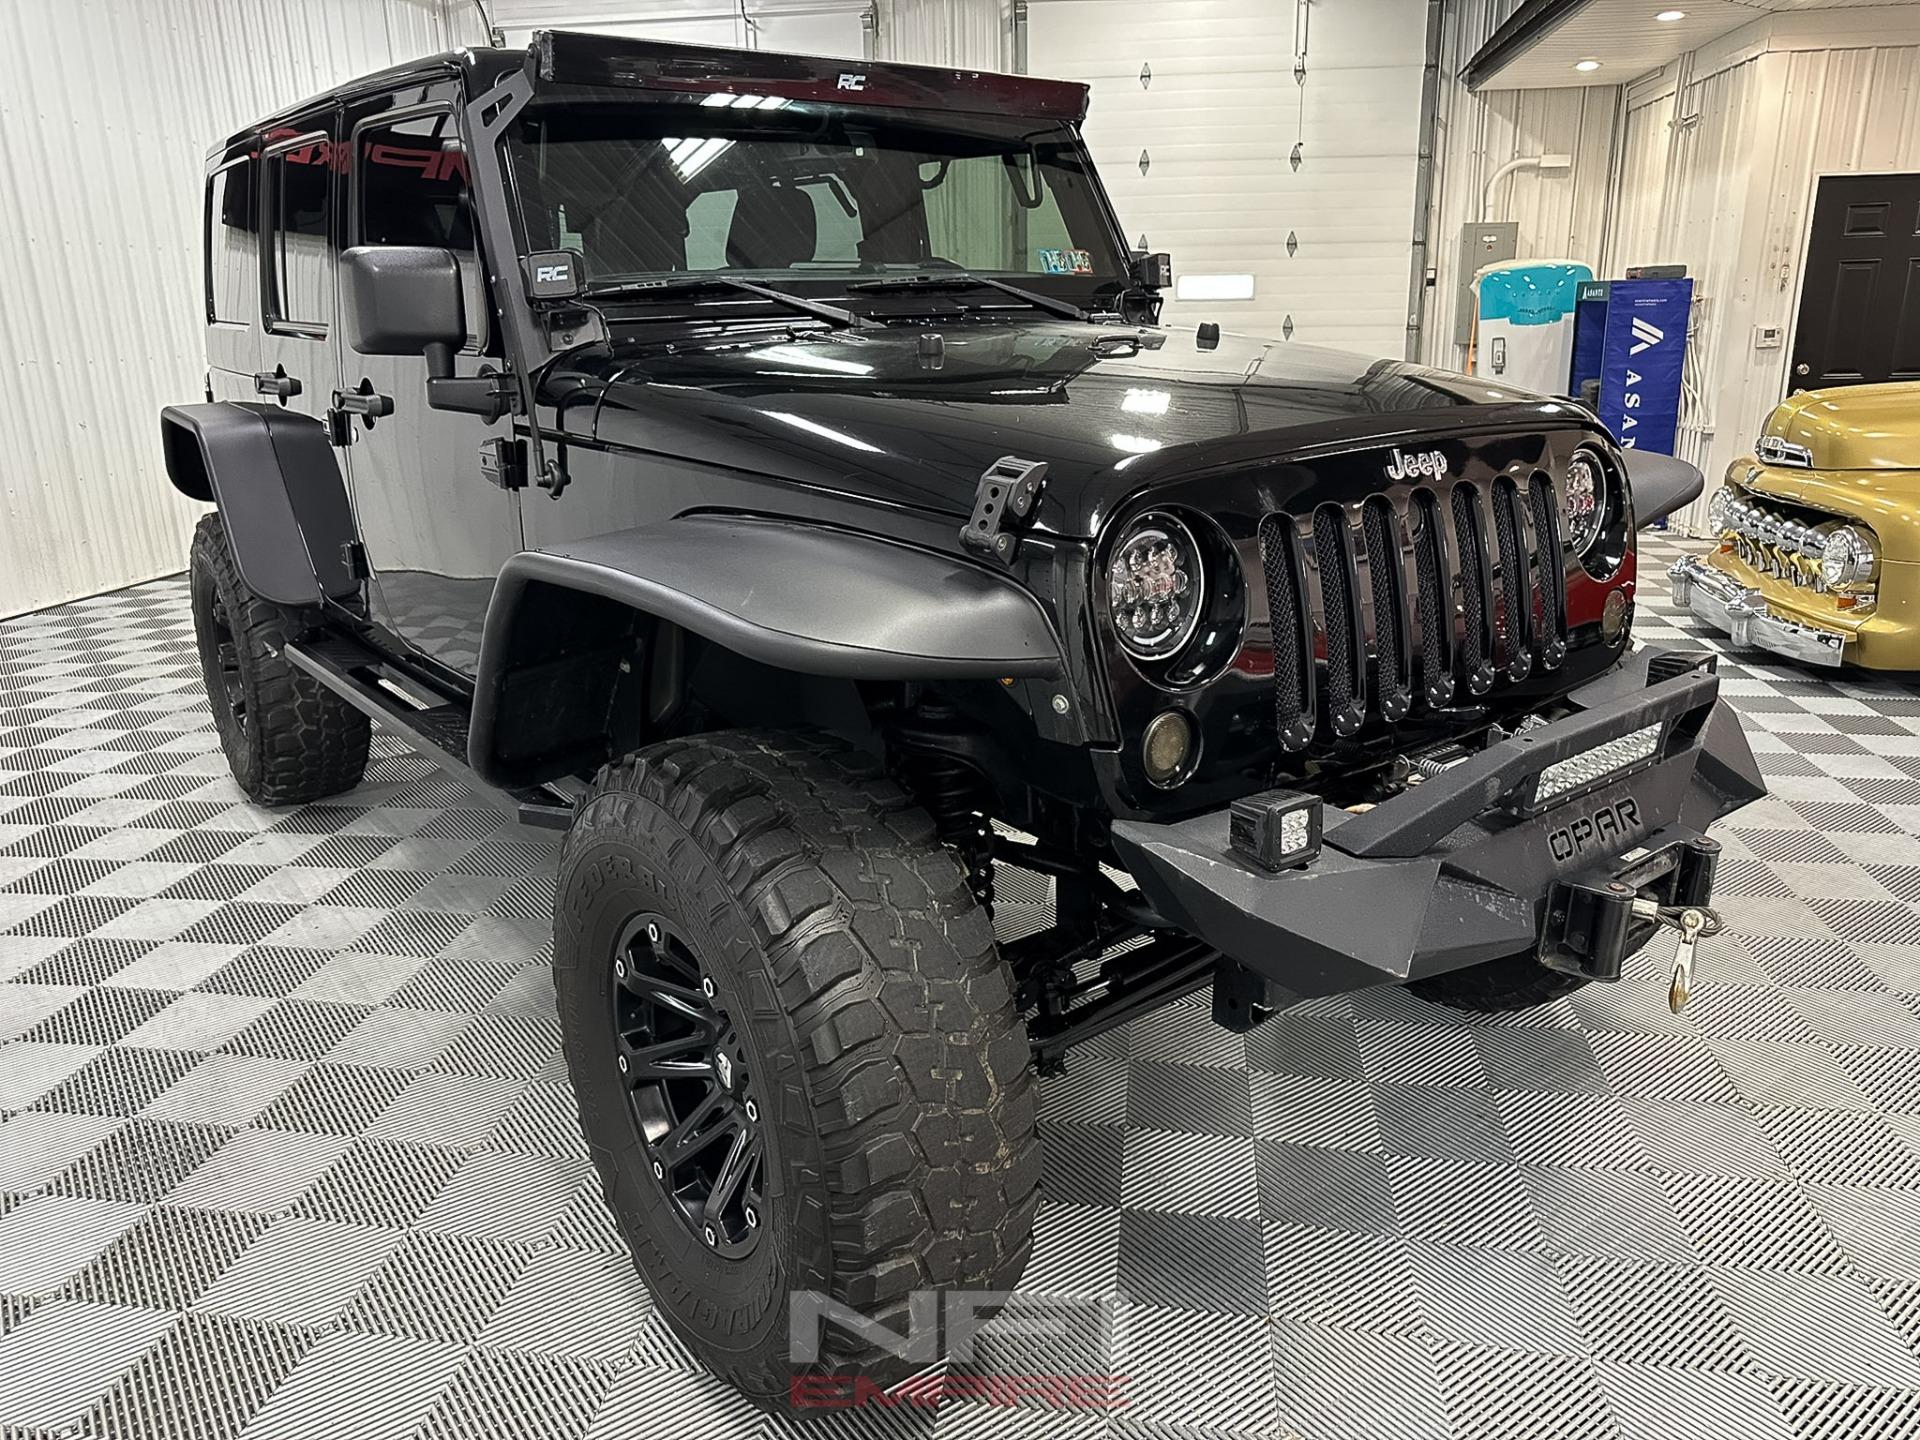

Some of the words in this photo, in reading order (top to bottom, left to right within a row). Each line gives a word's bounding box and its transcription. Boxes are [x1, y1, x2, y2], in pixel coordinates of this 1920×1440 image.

[837, 73, 866, 91] RC
[537, 265, 568, 282] RC
[1386, 448, 1448, 481] Jeep
[1548, 797, 1640, 862] OPAR
